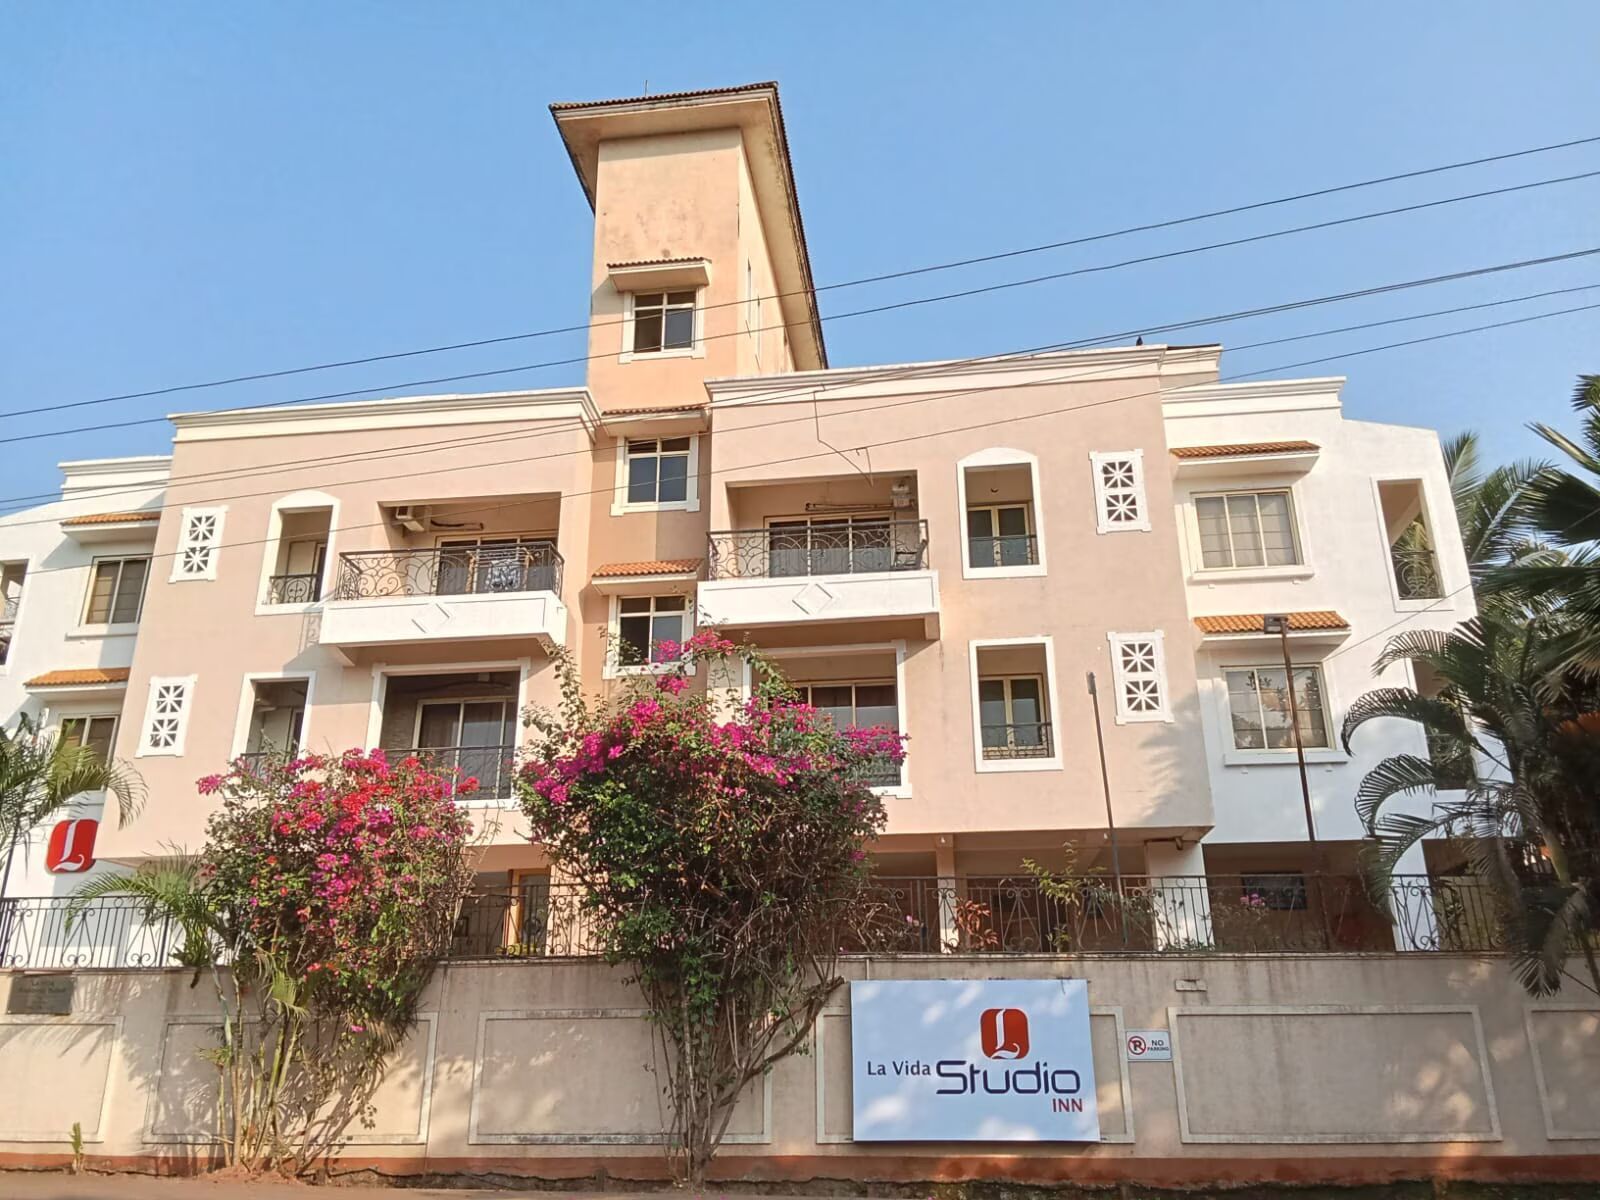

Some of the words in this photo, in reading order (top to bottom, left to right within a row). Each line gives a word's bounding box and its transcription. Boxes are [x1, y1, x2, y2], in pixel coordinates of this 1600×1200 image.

[867, 1061, 887, 1076] La
[892, 1060, 931, 1076] Vida
[935, 1060, 1081, 1095] Studio
[1052, 1098, 1083, 1113] INN
